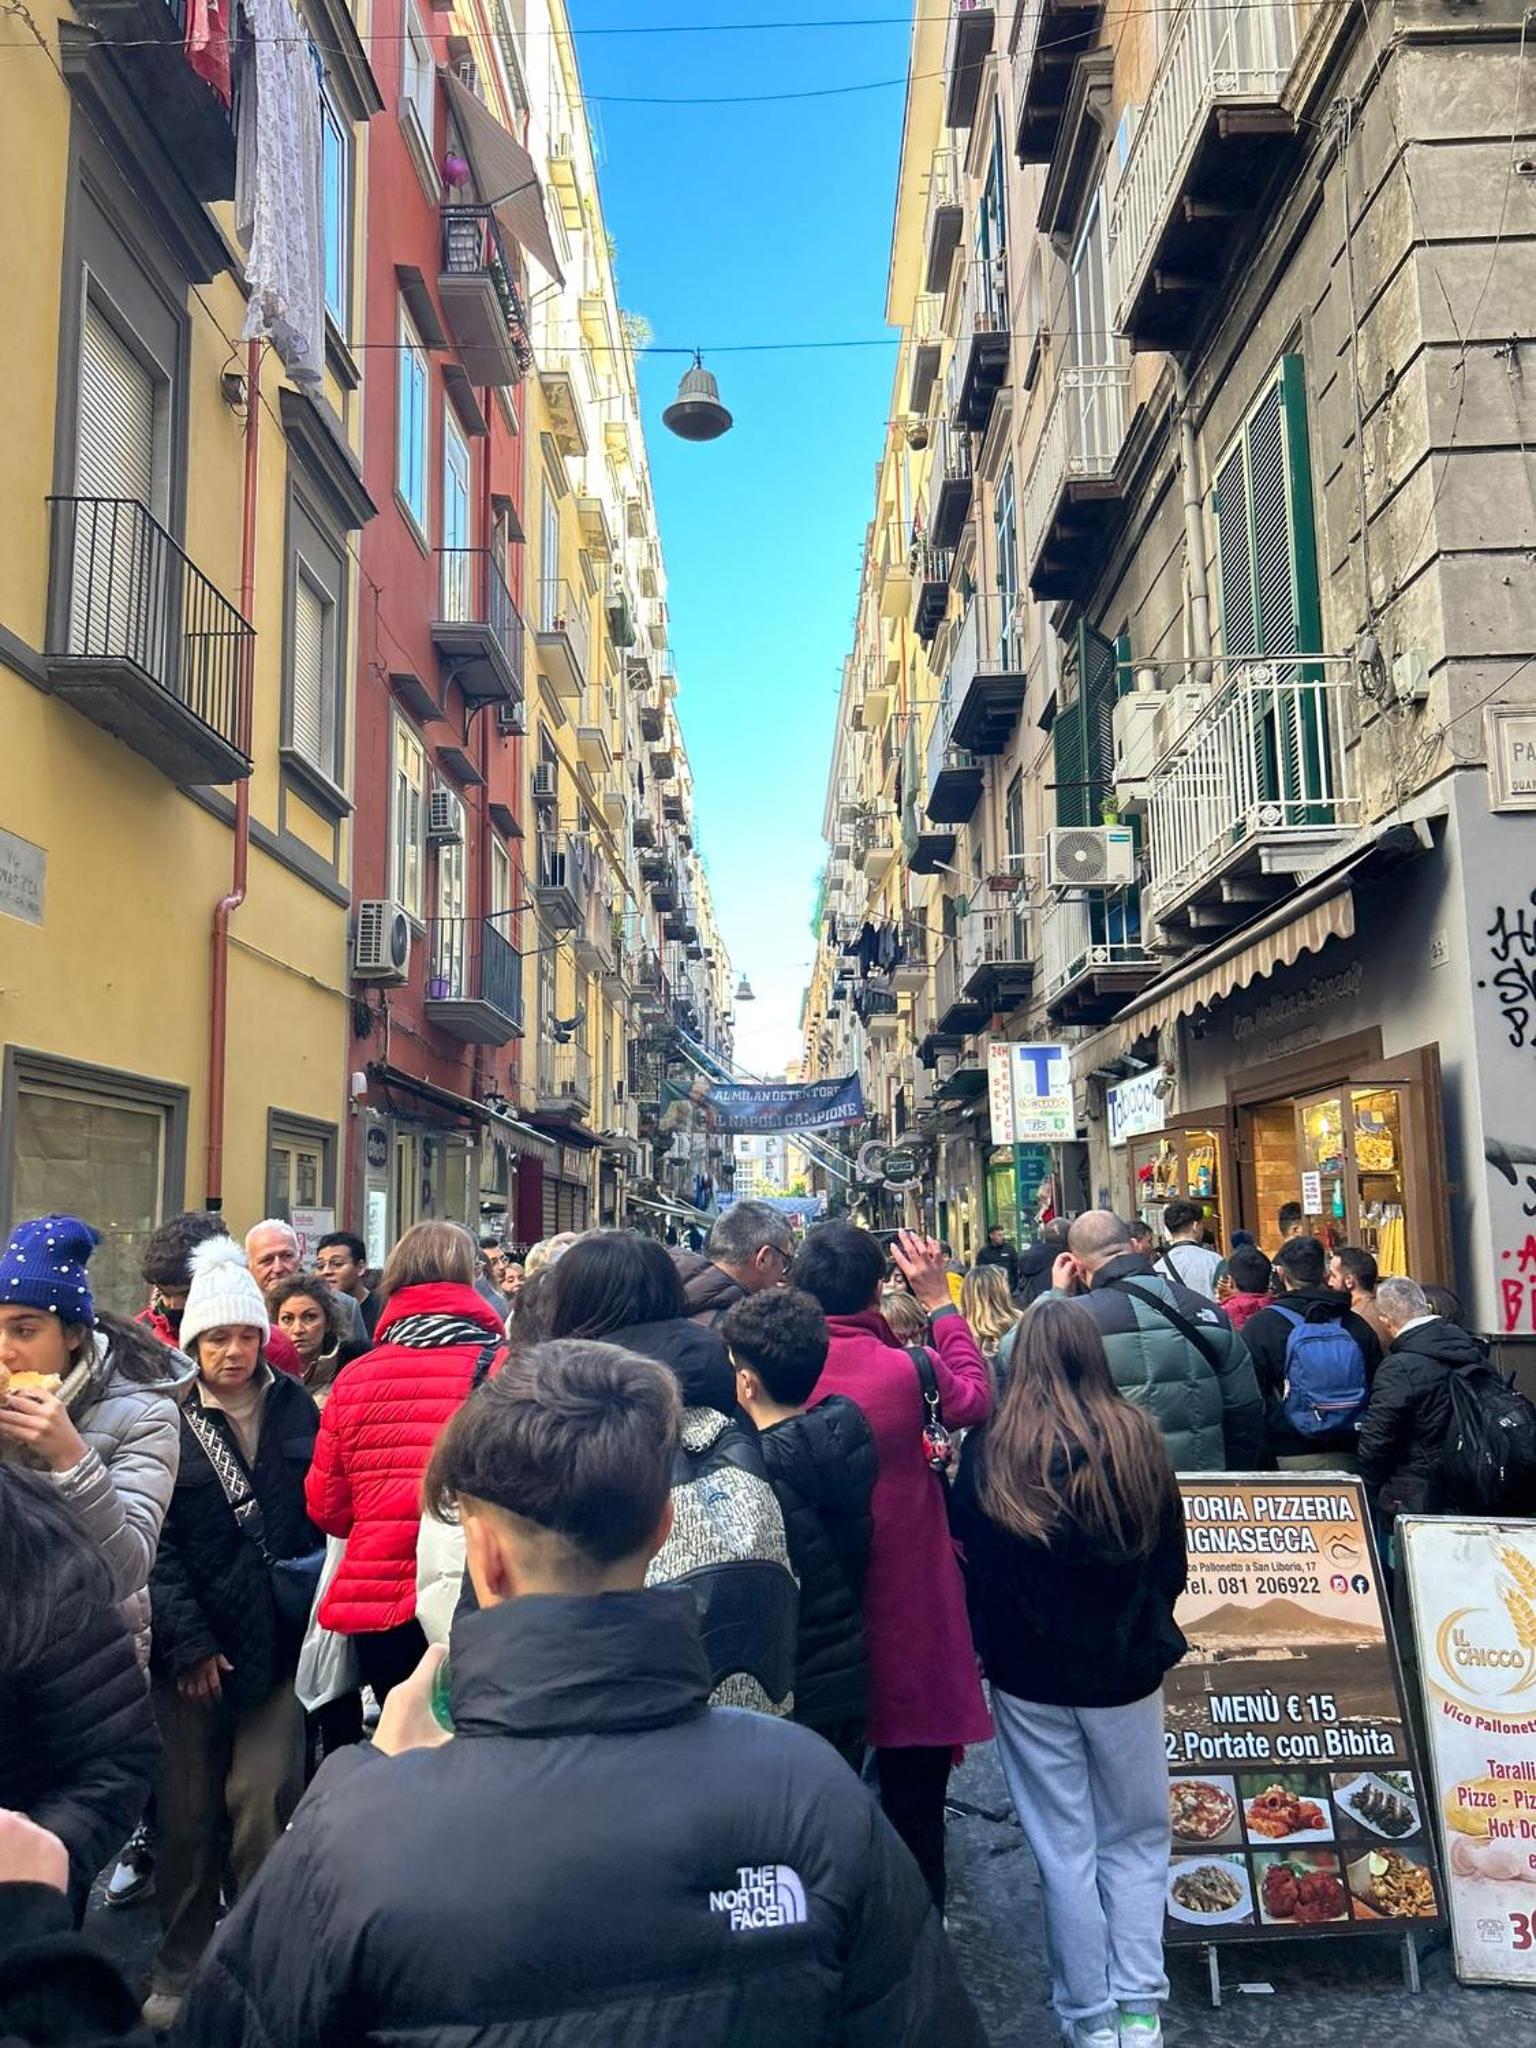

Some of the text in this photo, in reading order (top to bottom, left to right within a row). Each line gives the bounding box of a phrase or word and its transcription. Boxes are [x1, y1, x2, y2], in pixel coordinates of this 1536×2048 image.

[1019, 1047, 1062, 1096] T
[714, 1090, 730, 1101] AL
[731, 1090, 771, 1102] MILAN
[713, 1103, 858, 1128] IL NAPOLI CAMPIONE
[1252, 1495, 1357, 1521] PIZZERIA
[1187, 1526, 1319, 1553] IGNASECCA
[1200, 1562, 1243, 1572] Pallonetto
[1245, 1564, 1250, 1572] a
[1252, 1562, 1269, 1572] San
[1272, 1561, 1305, 1573] Liborio,
[1306, 1561, 1316, 1571] 17
[1185, 1576, 1321, 1594] Tel. 081 206922
[1453, 1629, 1470, 1647] IL
[1455, 1648, 1525, 1668] CHICCO
[1210, 1689, 1337, 1724] MENÙ € 15
[1443, 1702, 1472, 1725] Vico
[1165, 1728, 1395, 1759] 2 Portate con Bibita
[1457, 1787, 1497, 1808] Pizze
[1488, 1818, 1515, 1838] Hot
[737, 1865, 775, 1887] THE
[709, 1885, 776, 1912] NORTH
[731, 1905, 778, 1931] FACE
